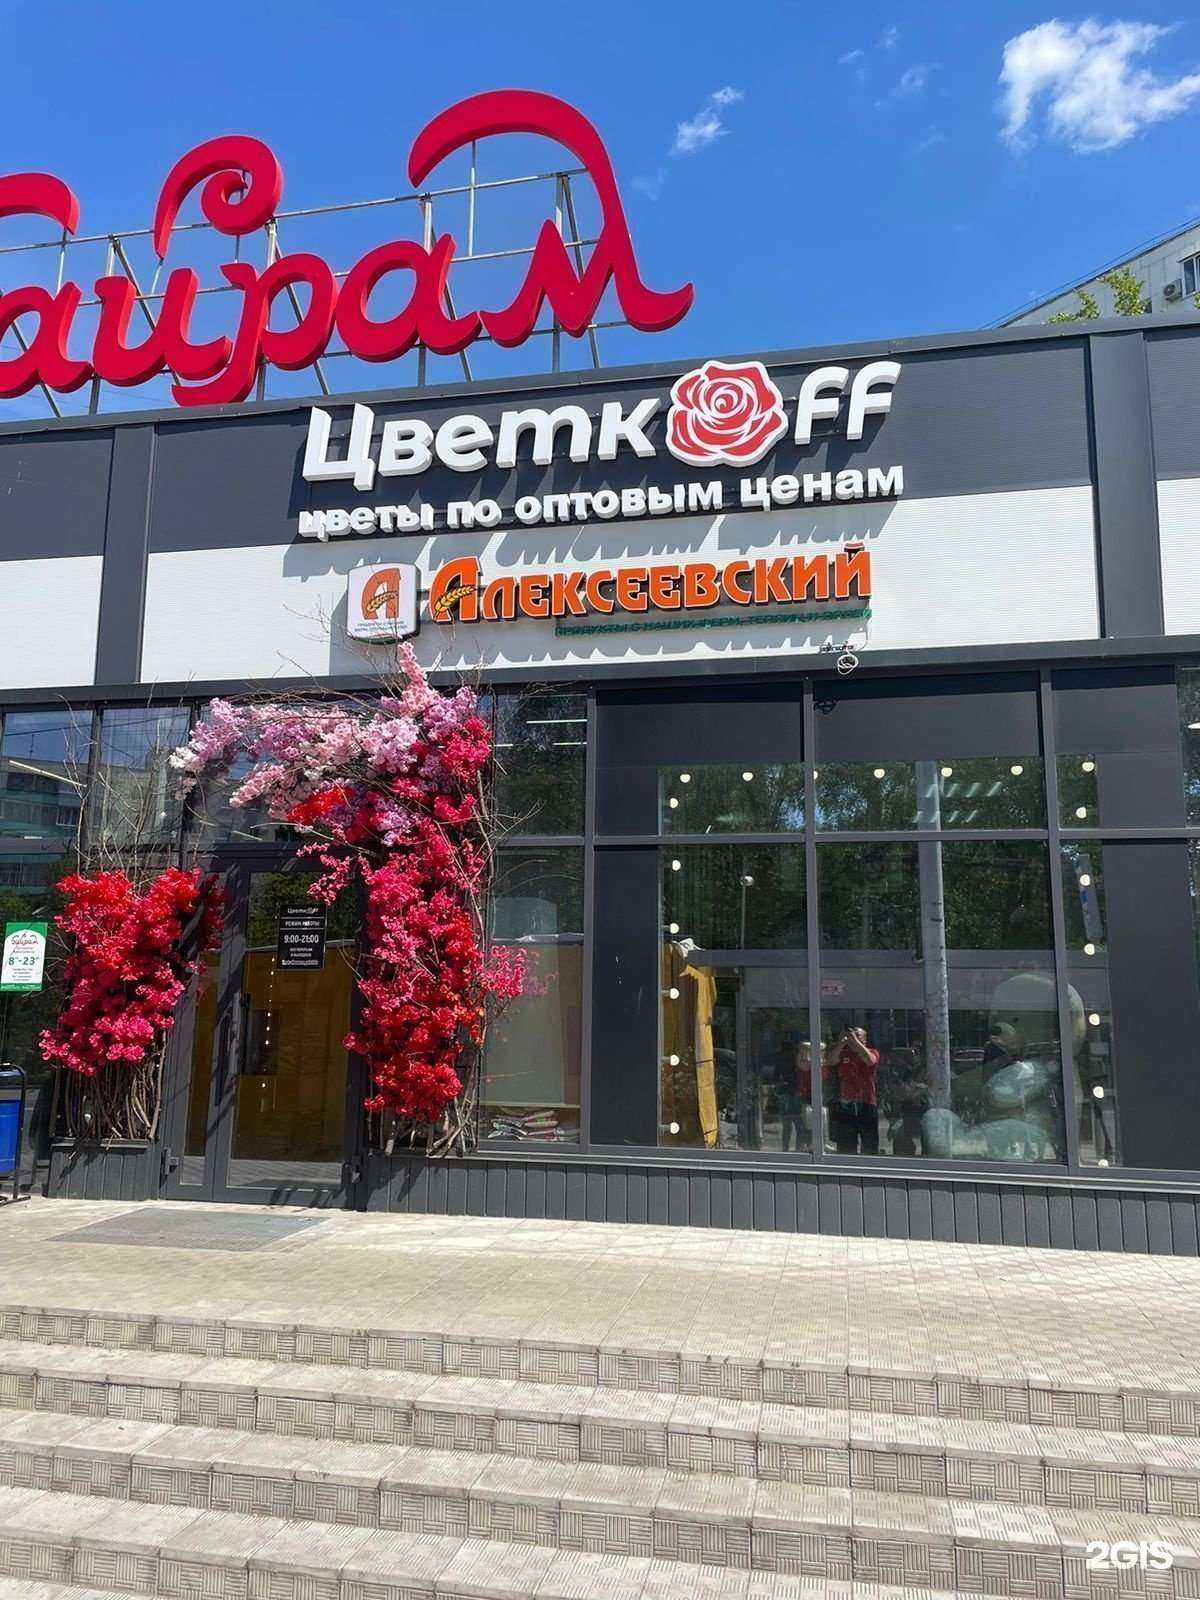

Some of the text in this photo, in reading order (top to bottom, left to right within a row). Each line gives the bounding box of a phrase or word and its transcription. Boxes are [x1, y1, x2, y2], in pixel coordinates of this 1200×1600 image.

[0, 89, 694, 407] айрам
[299, 465, 904, 542] цветы по оптовым ценам
